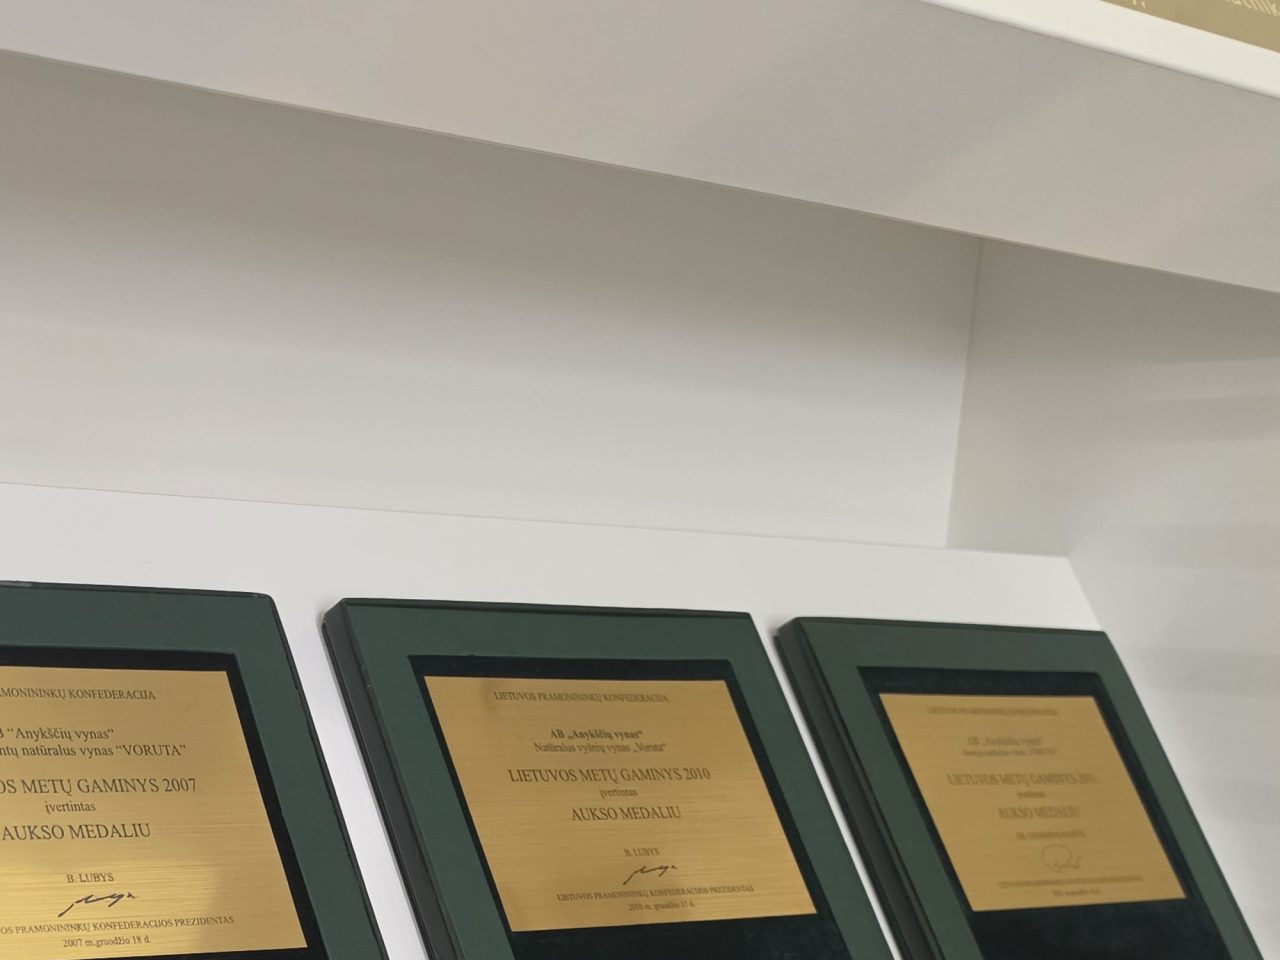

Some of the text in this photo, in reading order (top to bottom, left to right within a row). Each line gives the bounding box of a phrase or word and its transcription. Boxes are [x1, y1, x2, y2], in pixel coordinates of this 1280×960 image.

[69, 688, 157, 701] KONFEDERACIJA
[493, 691, 537, 701] LIETUVOS
[550, 729, 565, 739] AB
[21, 743, 77, 757] natūralus
[79, 746, 114, 759] vynas
[507, 767, 711, 785] LIETUVOS METŲ GAMINYS 2010
[21, 778, 73, 798] METŲ
[76, 777, 160, 794] GAMINYS
[162, 777, 197, 793] 2007
[44, 801, 97, 815] įvertintas
[571, 805, 682, 822] AUKSO MEDALIU
[1, 821, 152, 842] AUKSO MEDALIU
[632, 847, 660, 857] LUBYS
[66, 872, 114, 884] B. LUBYS
[14, 921, 92, 936] PRAMONININKŲ
[92, 918, 173, 932] KONFEDERACIJOS
[174, 915, 235, 928] PREZIDENTAS
[63, 937, 83, 948] 2007
[132, 935, 142, 945] 18
[143, 934, 152, 945] d.
